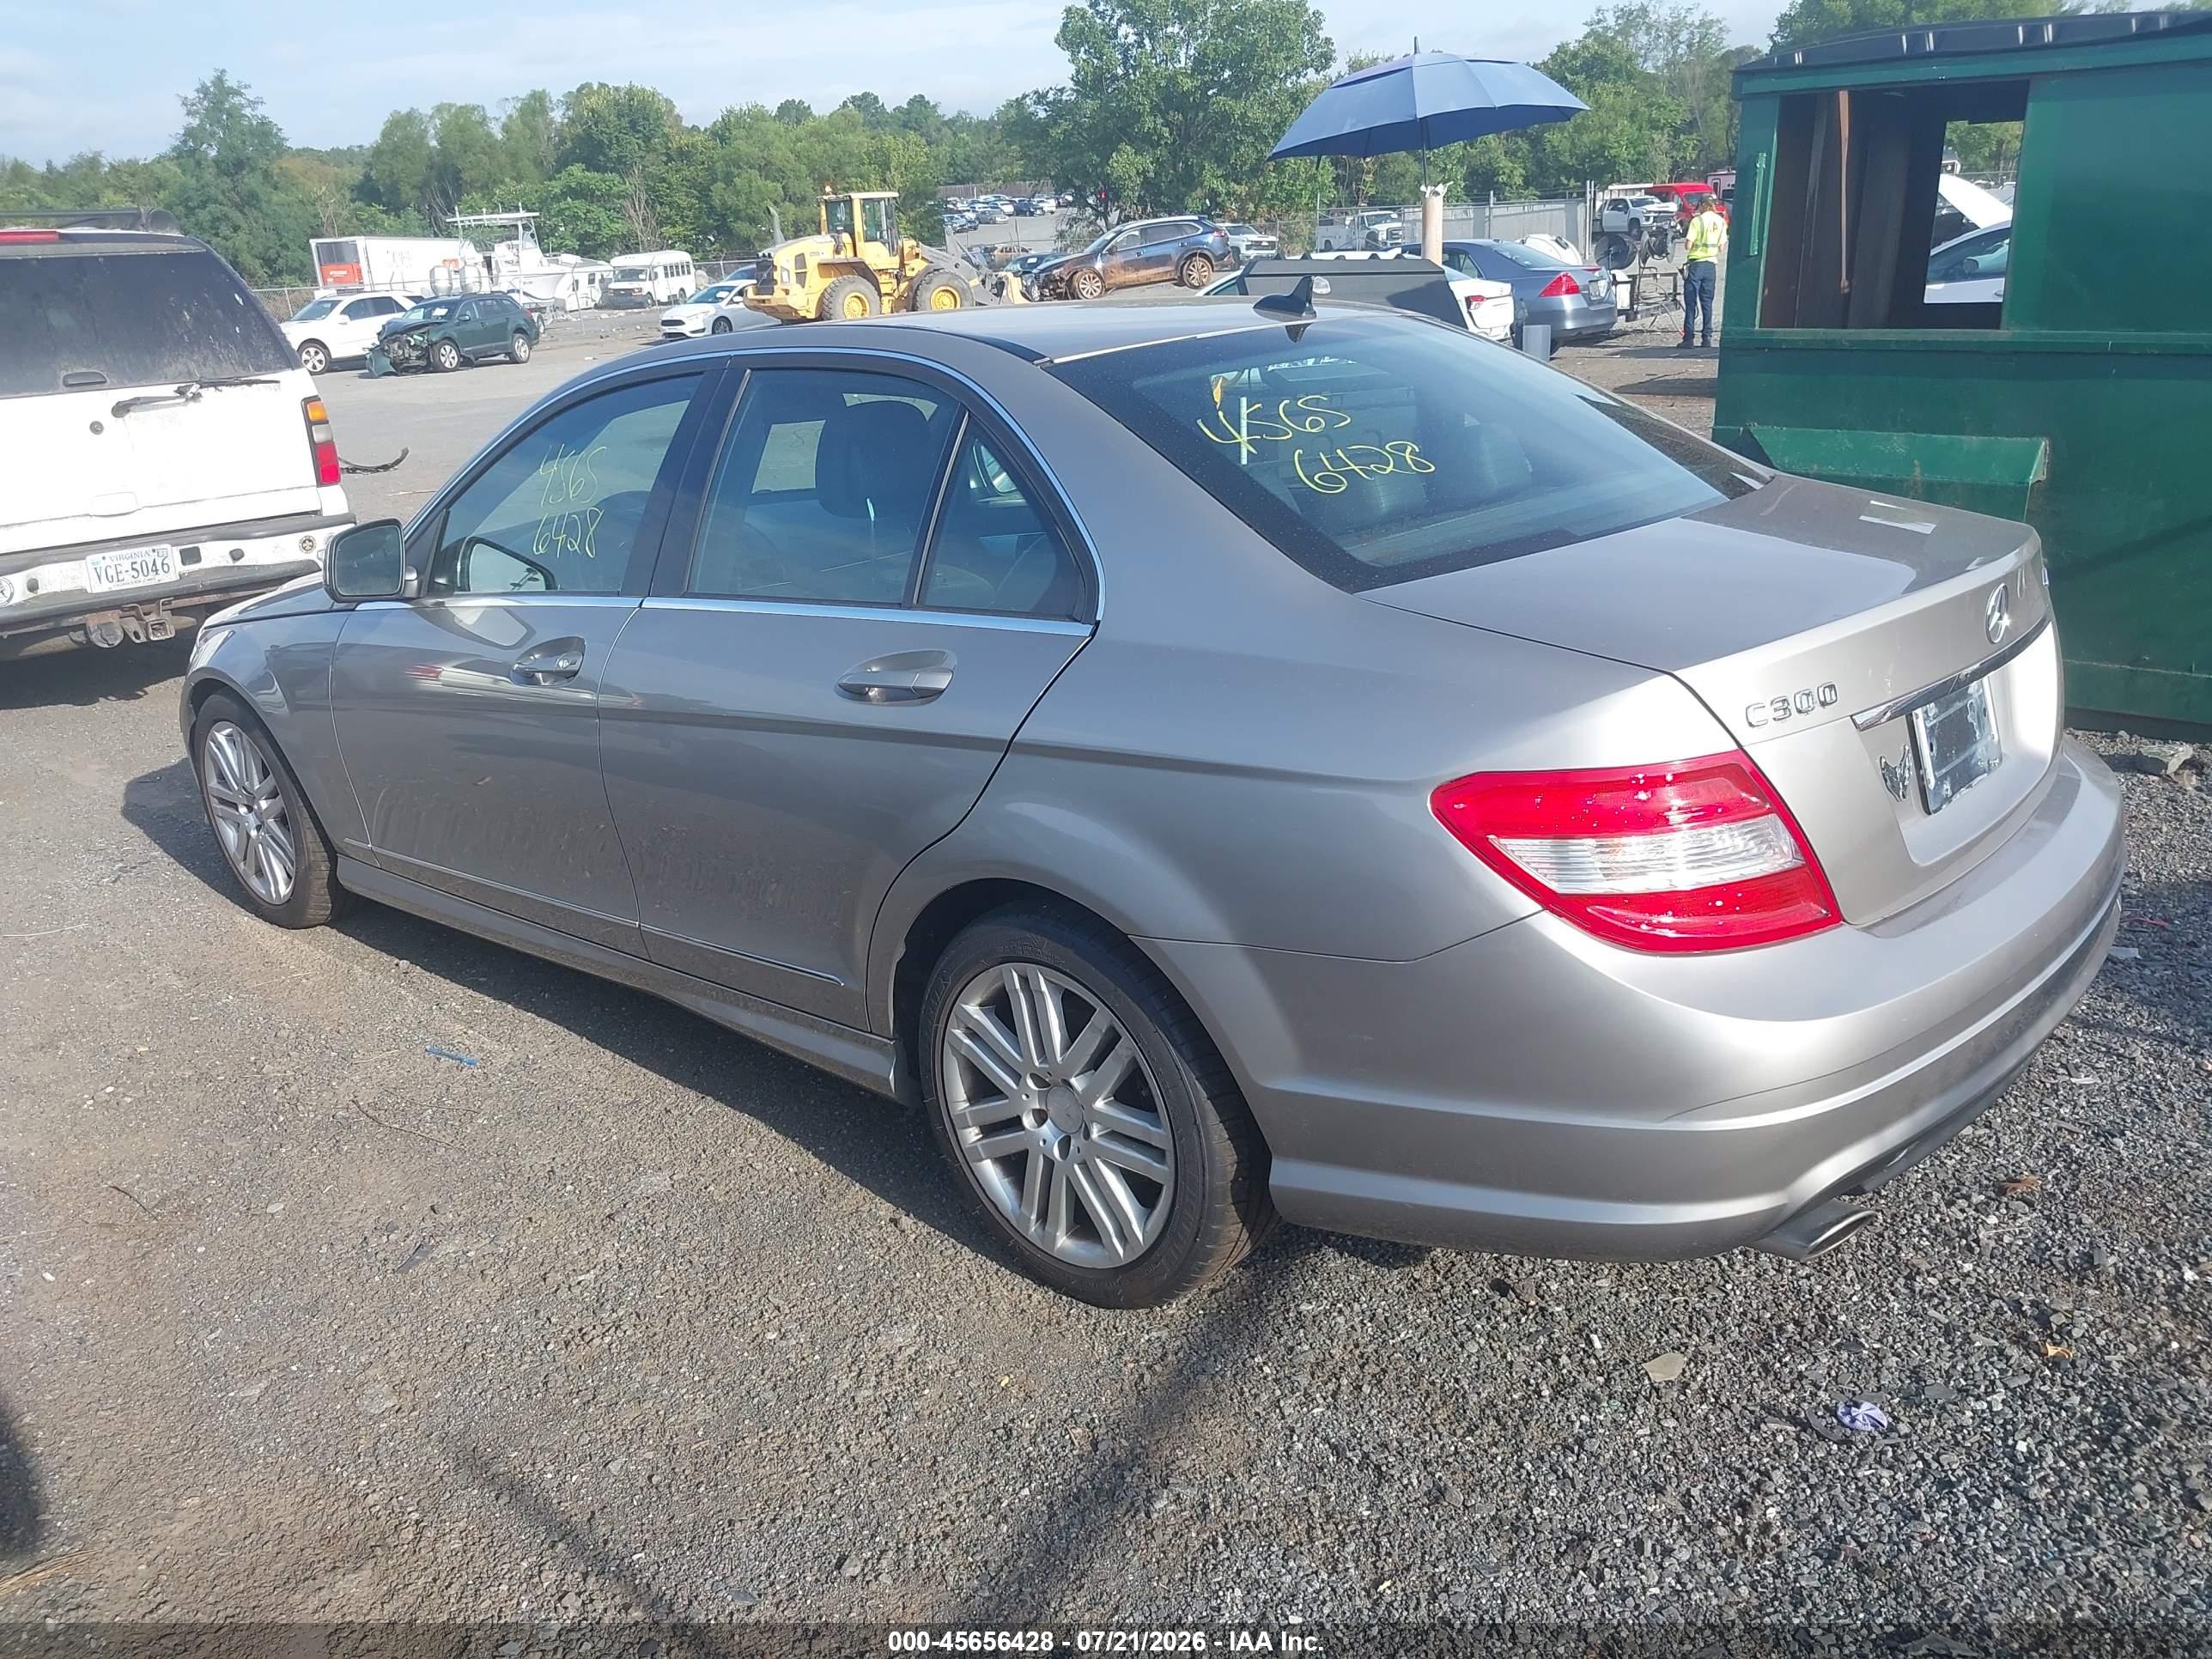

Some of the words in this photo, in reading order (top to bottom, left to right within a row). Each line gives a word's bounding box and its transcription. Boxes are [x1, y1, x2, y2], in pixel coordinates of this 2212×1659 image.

[1196, 395, 1352, 455] 4565
[538, 442, 607, 508] 4565
[1294, 441, 1436, 494] 6428
[108, 549, 151, 562] VIRGINIA
[532, 507, 605, 559] 6428
[94, 556, 170, 585] VGE-5046
[1745, 681, 1838, 728] C300
